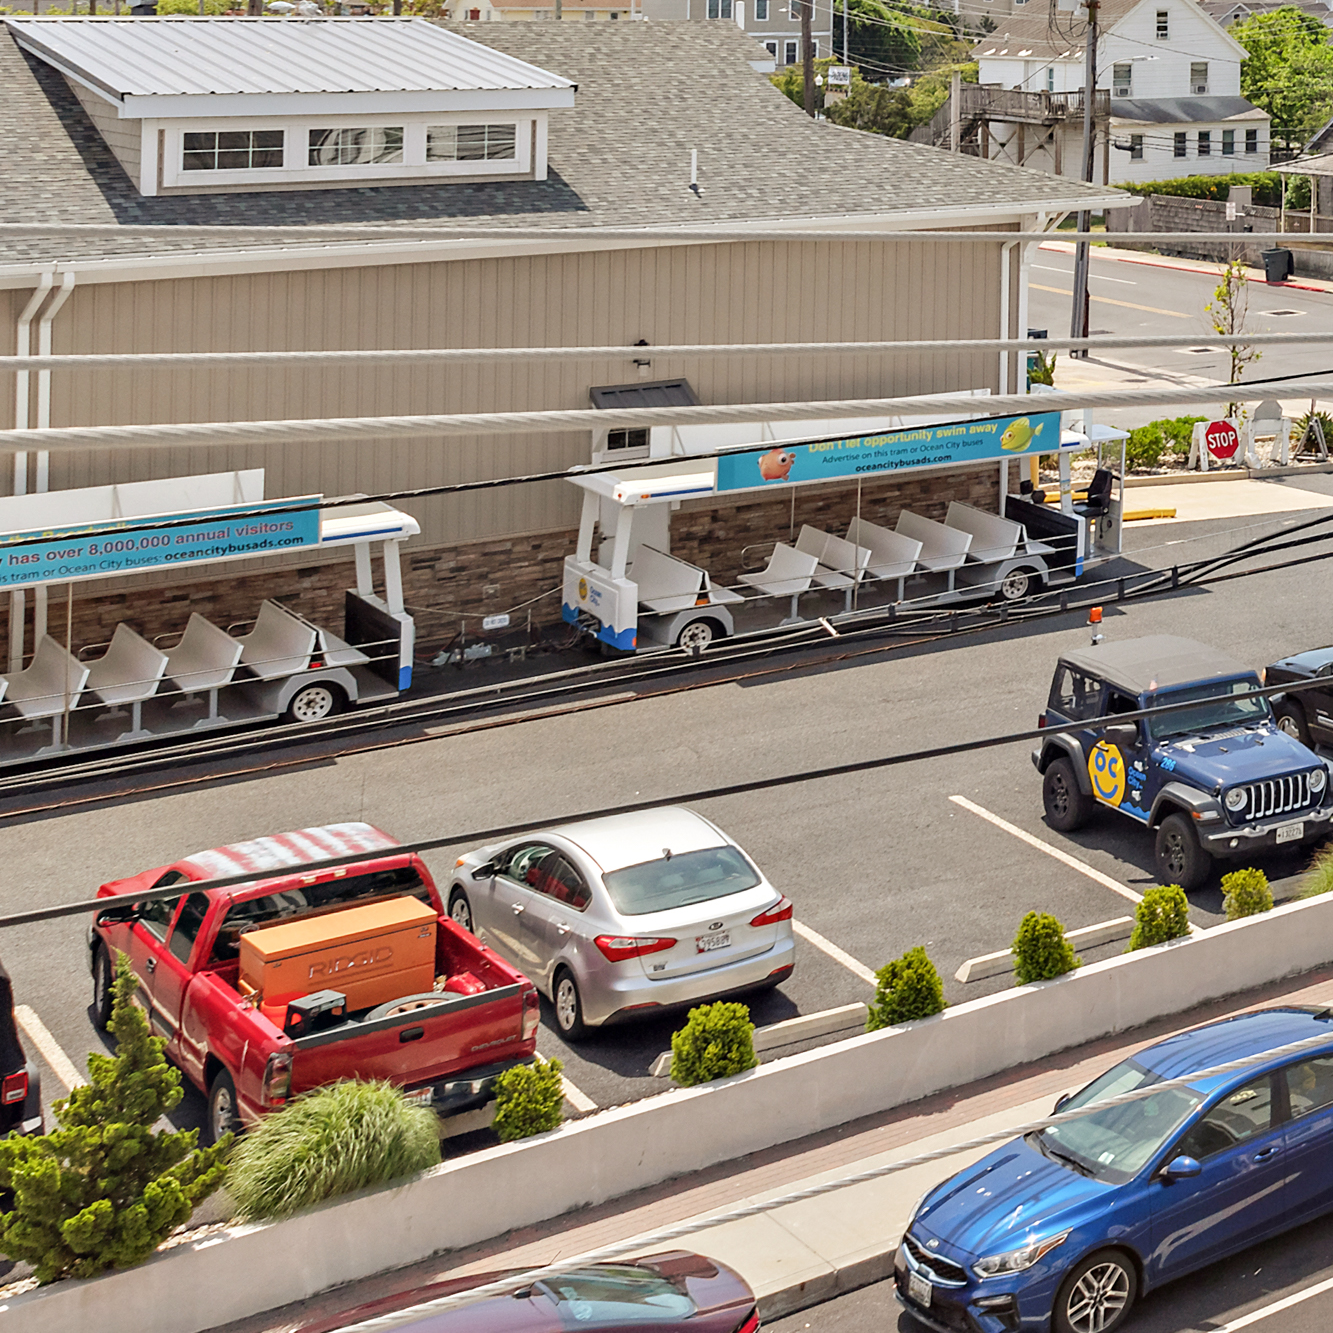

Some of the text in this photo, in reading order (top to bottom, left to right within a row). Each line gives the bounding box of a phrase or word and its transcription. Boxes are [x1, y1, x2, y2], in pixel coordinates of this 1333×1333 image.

[808, 422, 998, 453] Don't let opportunity swim away
[822, 452, 860, 464] Advertise
[874, 448, 888, 458] this
[889, 448, 908, 456] tram
[910, 446, 919, 454] or
[920, 443, 944, 453] Ocean
[945, 441, 960, 451] City
[962, 438, 984, 447] buses
[1208, 431, 1235, 449] STOP
[855, 454, 952, 473] oceancitybusads.com
[8, 552, 41, 566] has
[45, 547, 84, 561] over
[88, 534, 171, 557] 8,000,000
[175, 526, 231, 545] annual
[235, 521, 294, 536] visitors
[11, 569, 39, 580] tram
[43, 567, 55, 577] or
[58, 562, 96, 575] Ocean
[99, 559, 123, 571] City
[126, 553, 163, 566] buses:
[164, 536, 304, 562] oceancitybusads.com
[309, 946, 394, 979] RIDGID
